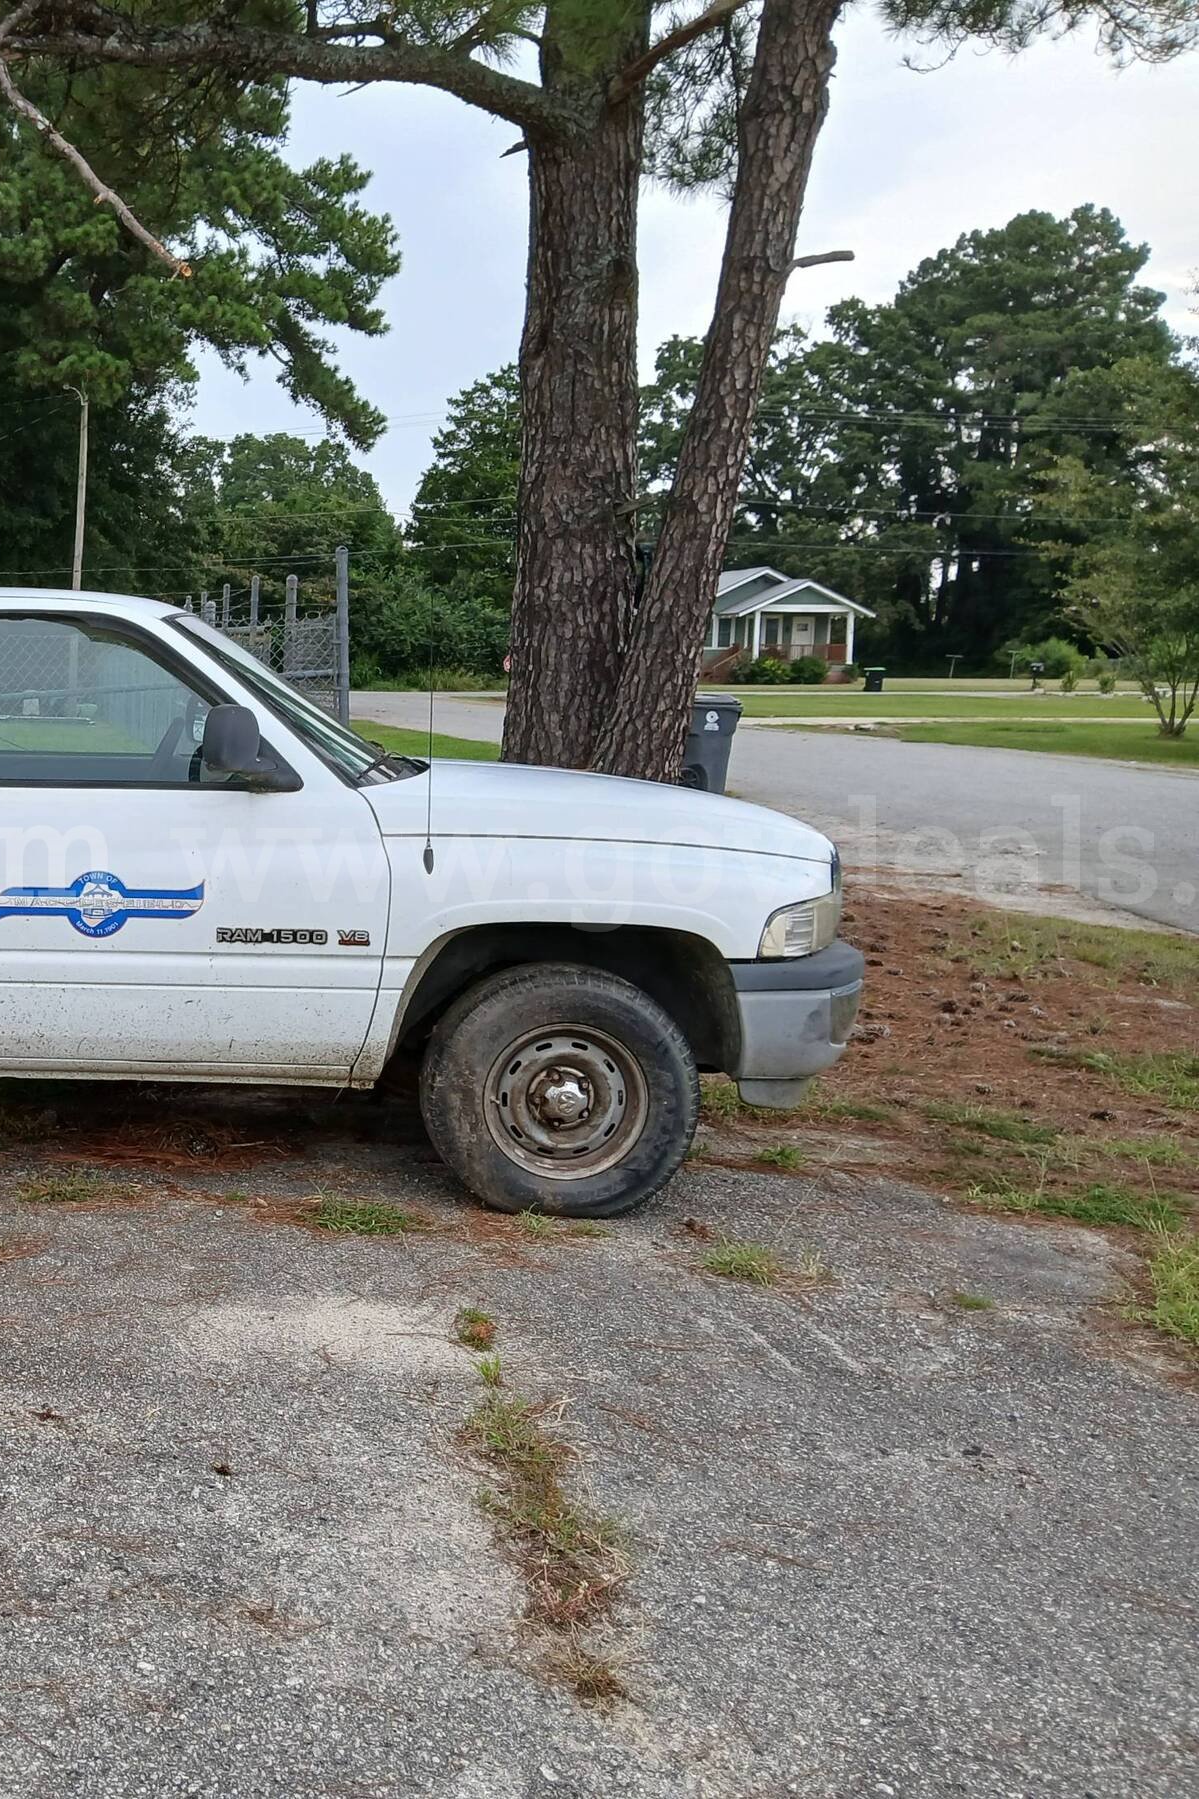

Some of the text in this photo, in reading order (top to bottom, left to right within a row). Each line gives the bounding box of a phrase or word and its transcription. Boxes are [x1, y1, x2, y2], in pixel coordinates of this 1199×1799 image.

[78, 872, 118, 884] TOWN OF
[76, 920, 95, 934] March
[216, 928, 370, 944] RAM 1500 V8
